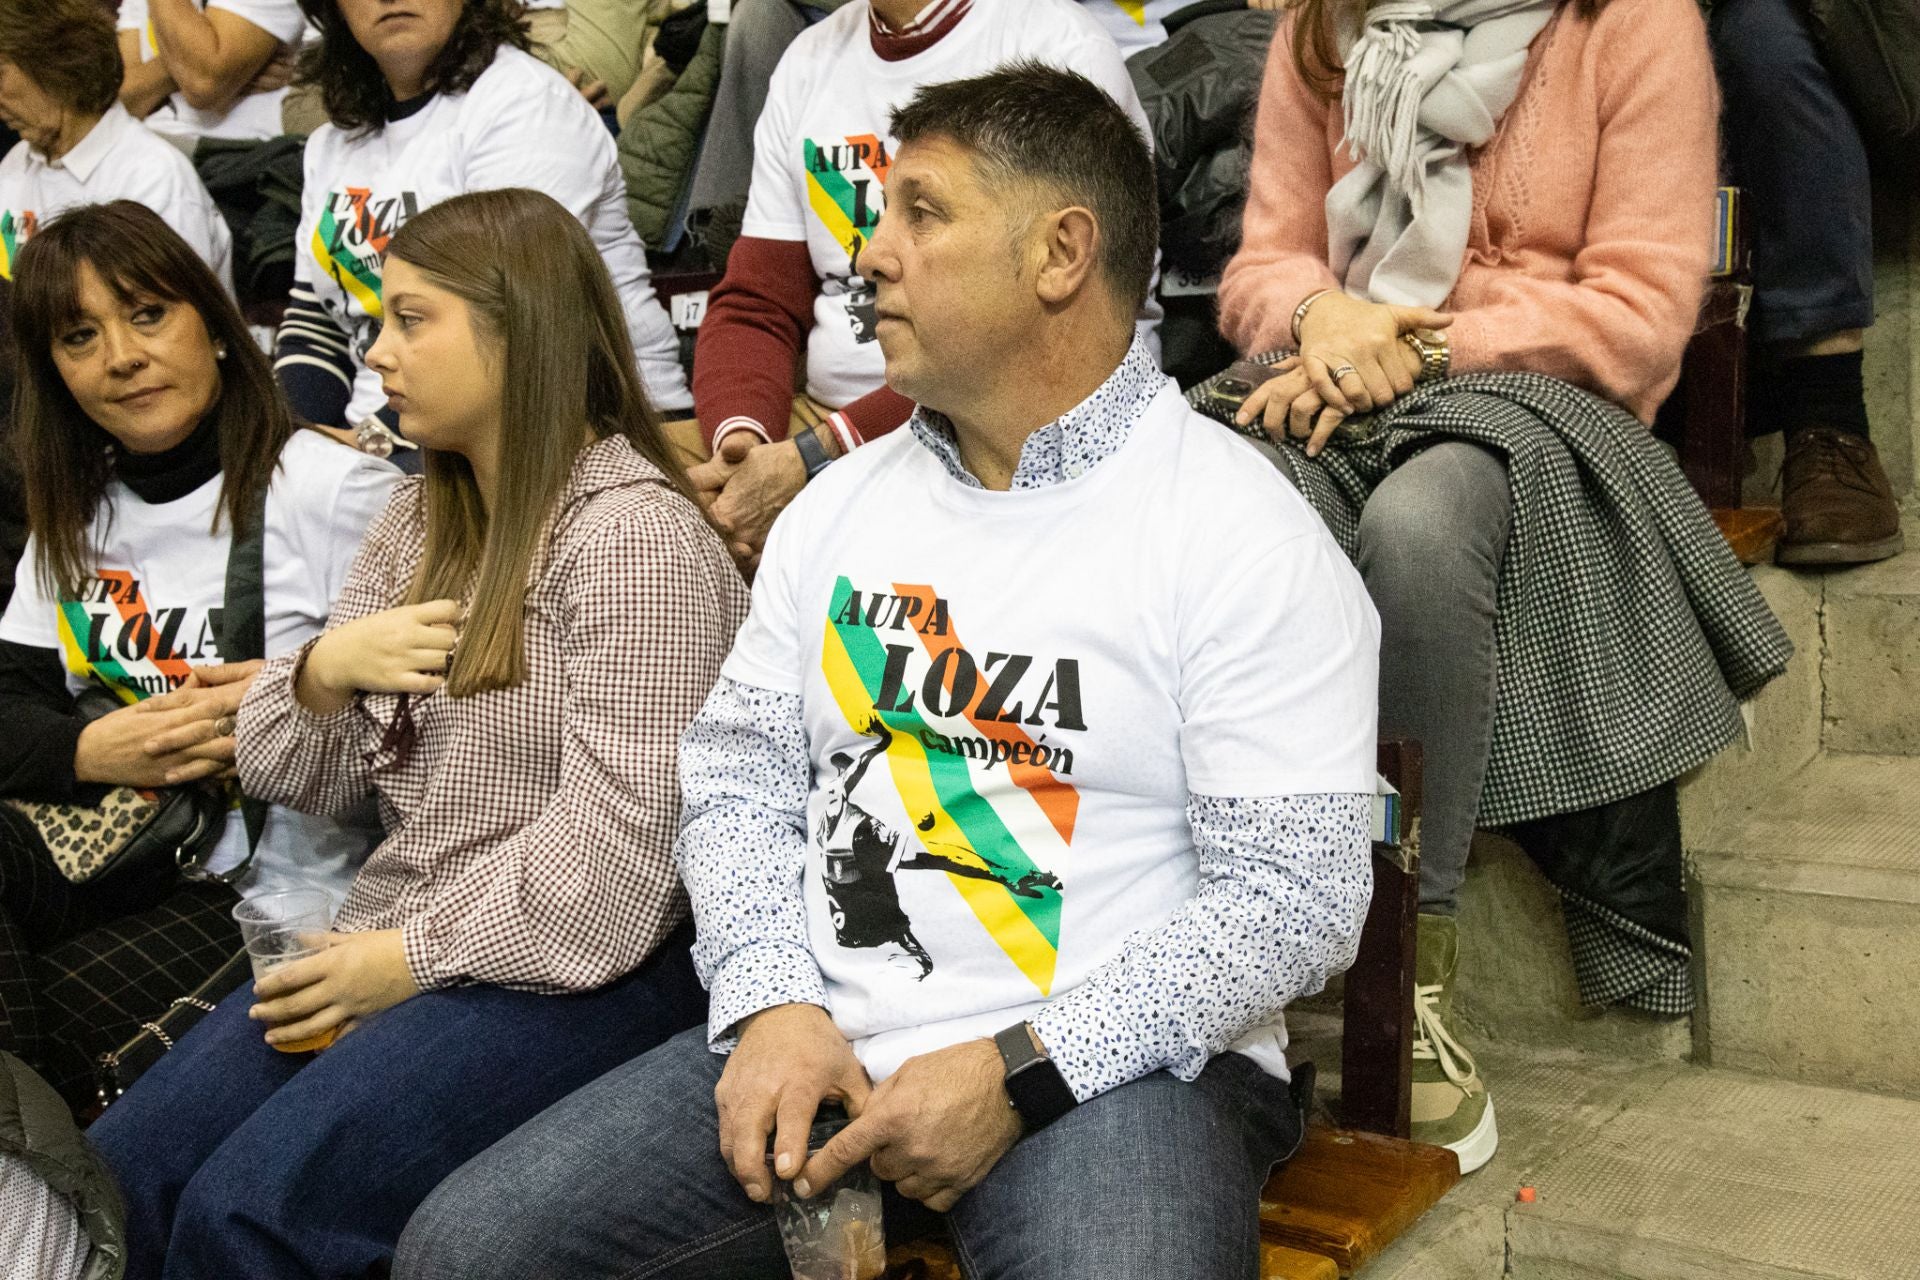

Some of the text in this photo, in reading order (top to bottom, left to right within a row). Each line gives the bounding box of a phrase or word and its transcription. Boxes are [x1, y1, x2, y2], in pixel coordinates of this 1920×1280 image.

[812, 141, 888, 173] AUPA
[834, 590, 948, 636] AUPA
[872, 643, 1088, 732] LOZA
[919, 729, 1074, 776] campeón
